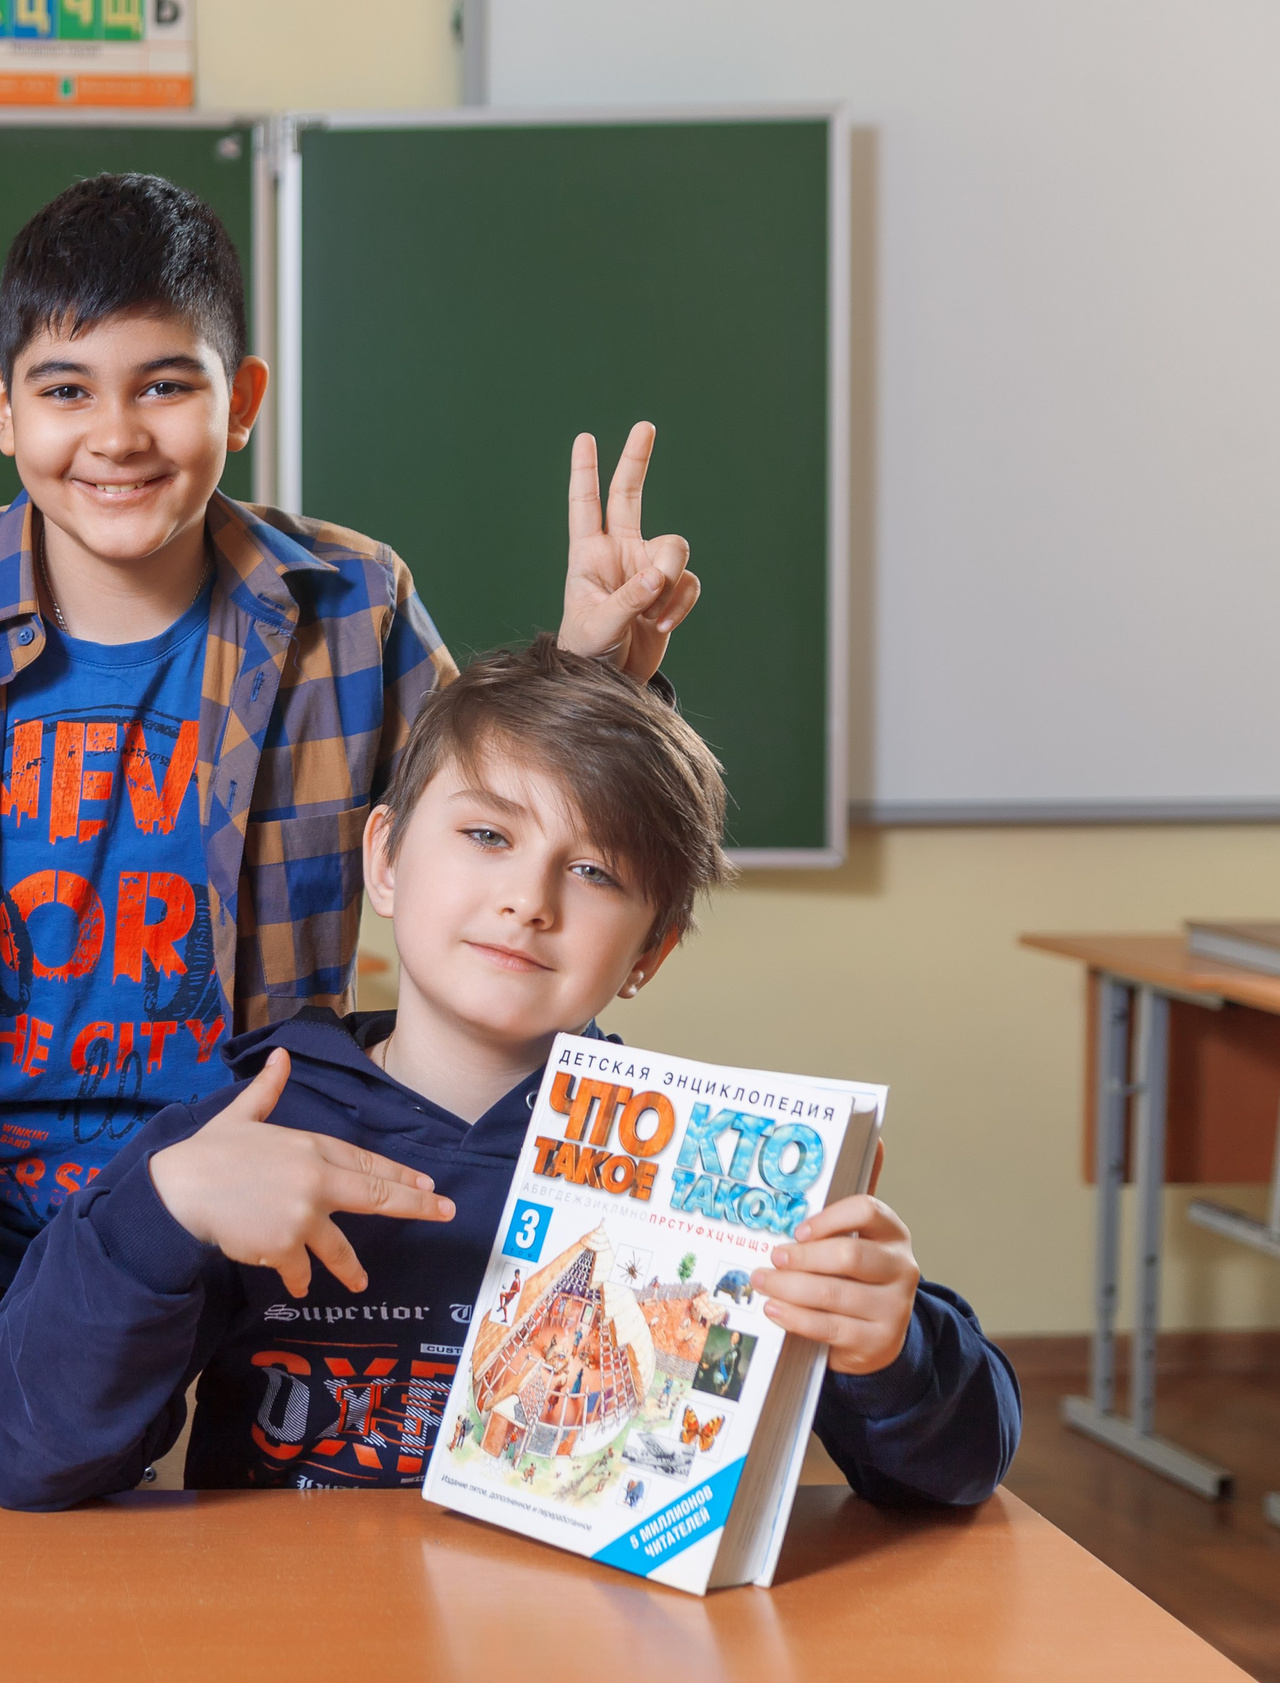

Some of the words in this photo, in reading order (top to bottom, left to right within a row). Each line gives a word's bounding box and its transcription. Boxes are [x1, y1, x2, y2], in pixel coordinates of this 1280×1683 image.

[71, 1015, 226, 1079] CITY
[549, 1070, 676, 1157] ЧТО
[558, 1049, 651, 1081] ДЕТСКАЯ
[663, 1072, 836, 1122] ЭНЦИКЛОПЕДИЯ
[0, 1136, 31, 1150] BAND
[533, 1135, 659, 1201] ТАКОЕ
[677, 1101, 825, 1192] КТО
[515, 1208, 540, 1249] 3
[671, 1167, 808, 1238] ТАКОЙ
[264, 1302, 431, 1324] Superior
[639, 1485, 713, 1543] МИЛЛИОНОВ
[644, 1505, 711, 1558] ЧИТАТЕЛЕЙ
